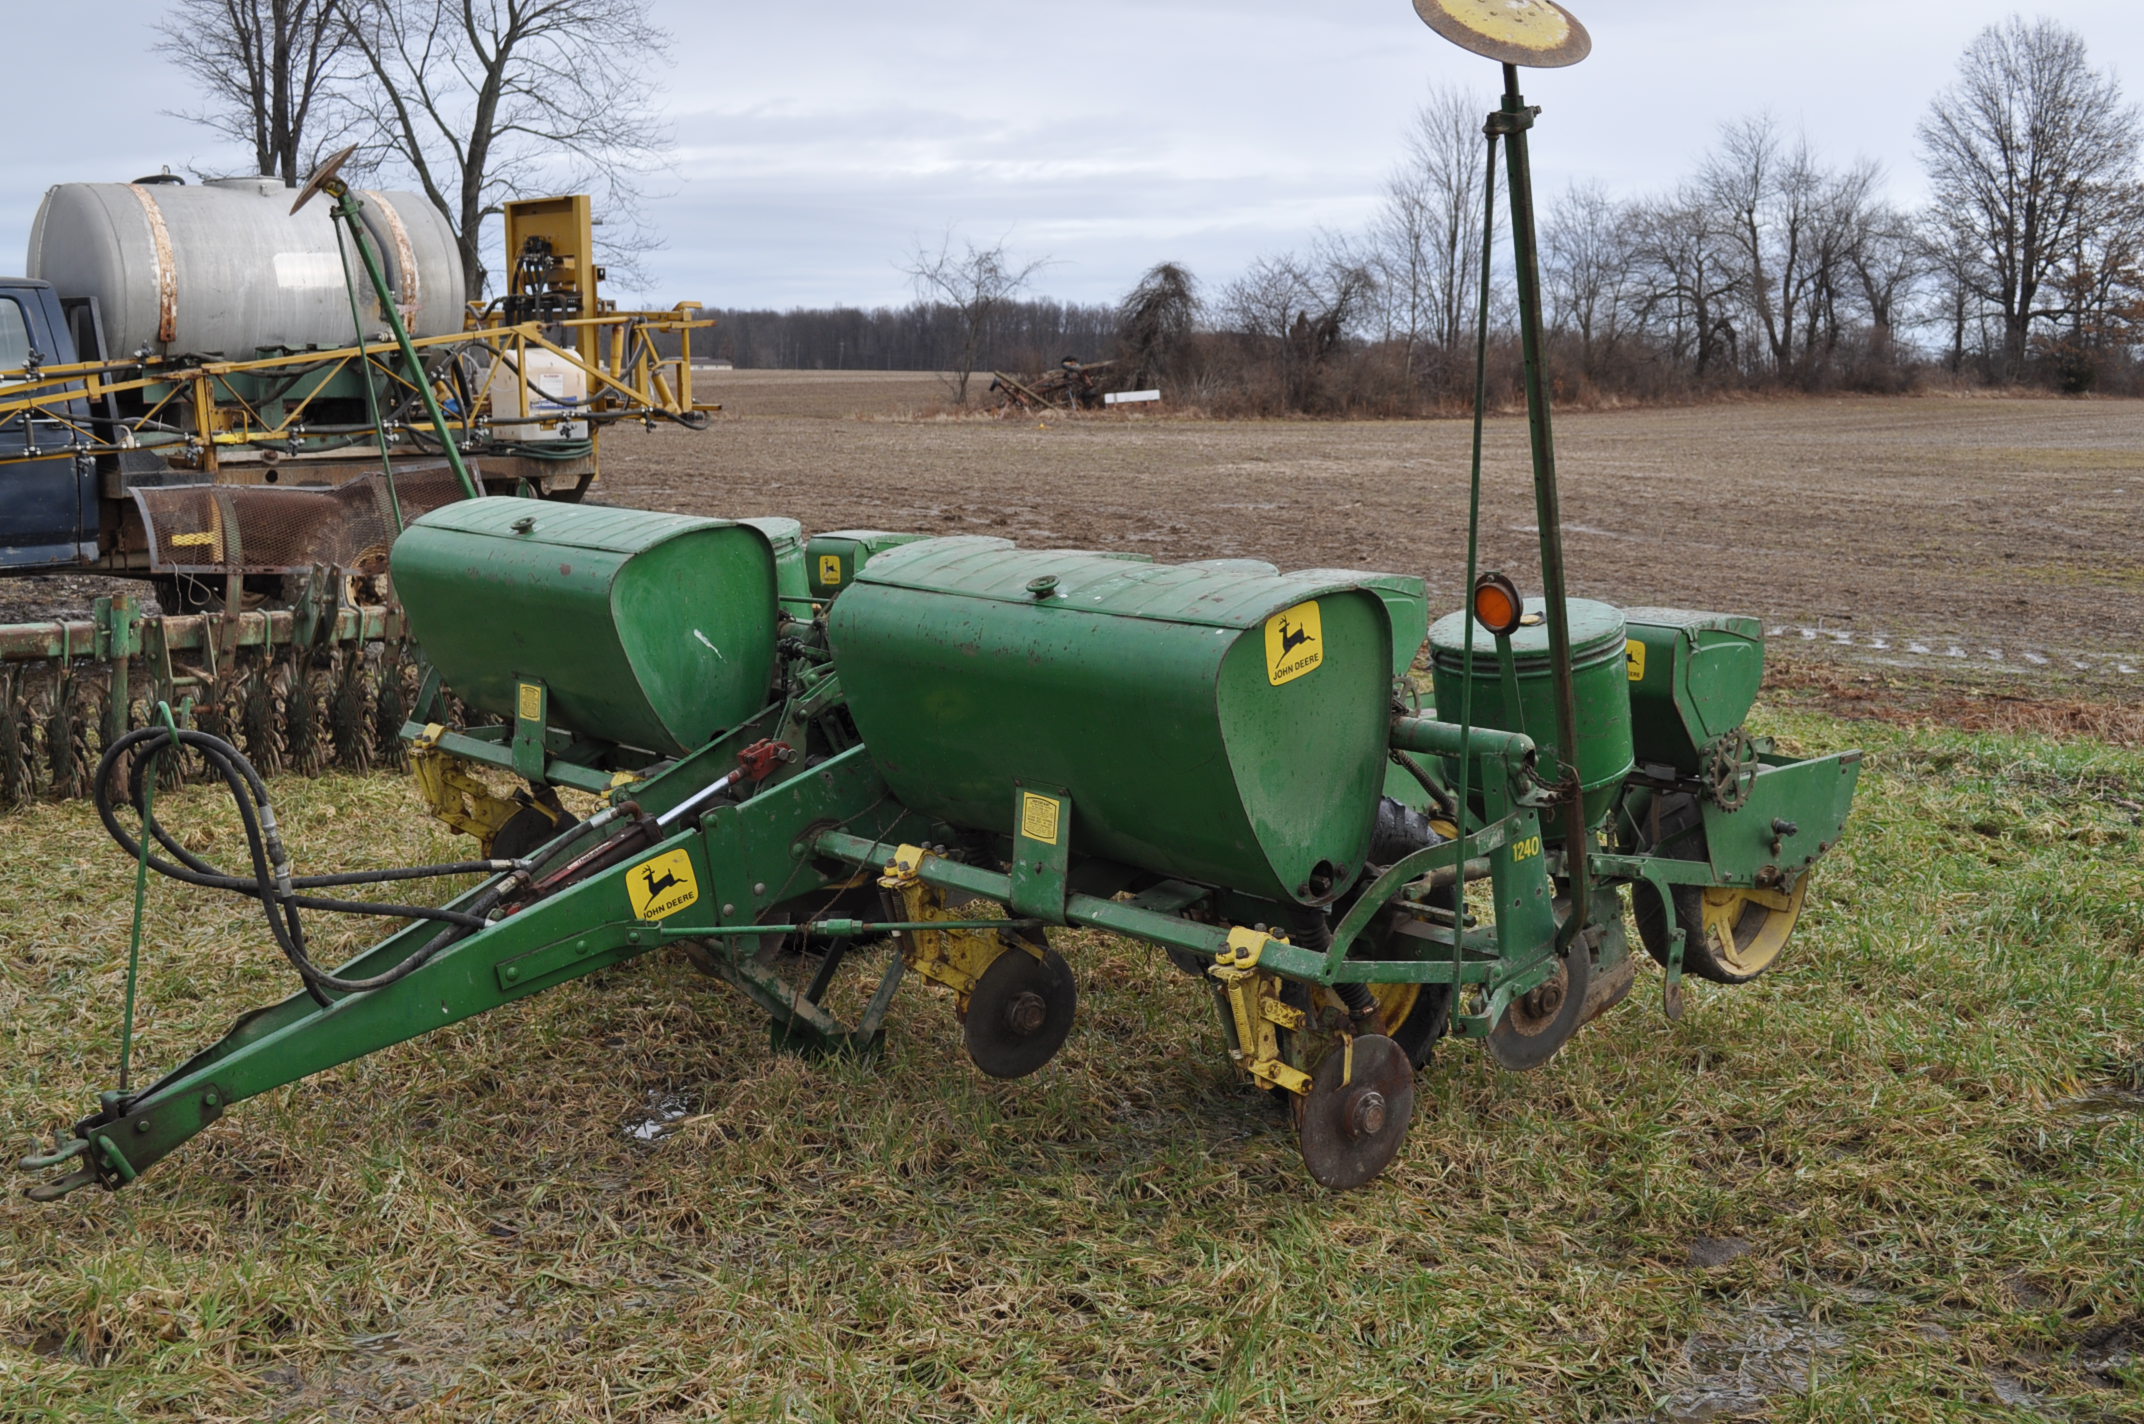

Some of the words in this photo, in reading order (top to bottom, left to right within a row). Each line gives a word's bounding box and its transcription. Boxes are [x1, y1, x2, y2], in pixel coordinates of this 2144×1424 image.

[1273, 664, 1294, 680] JOHN
[1294, 652, 1320, 671] DEERE
[1512, 836, 1540, 862] 1240
[643, 904, 666, 919] JOHN
[665, 891, 695, 910] DEERE
